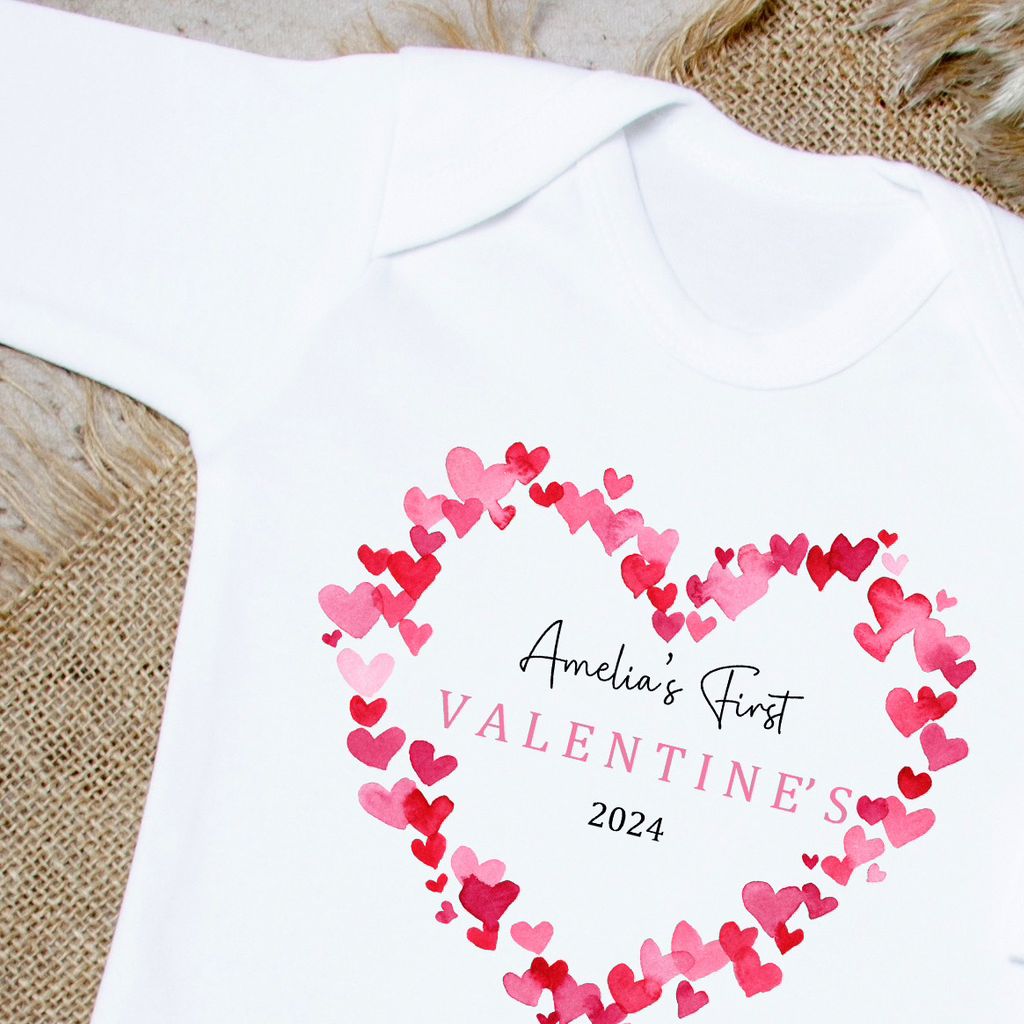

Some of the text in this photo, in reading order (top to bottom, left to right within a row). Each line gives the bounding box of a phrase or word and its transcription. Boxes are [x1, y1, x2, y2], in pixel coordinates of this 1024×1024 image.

[519, 619, 805, 735] Amelia's First
[440, 689, 854, 824] VALENTINE'S
[587, 801, 665, 842] 2024
